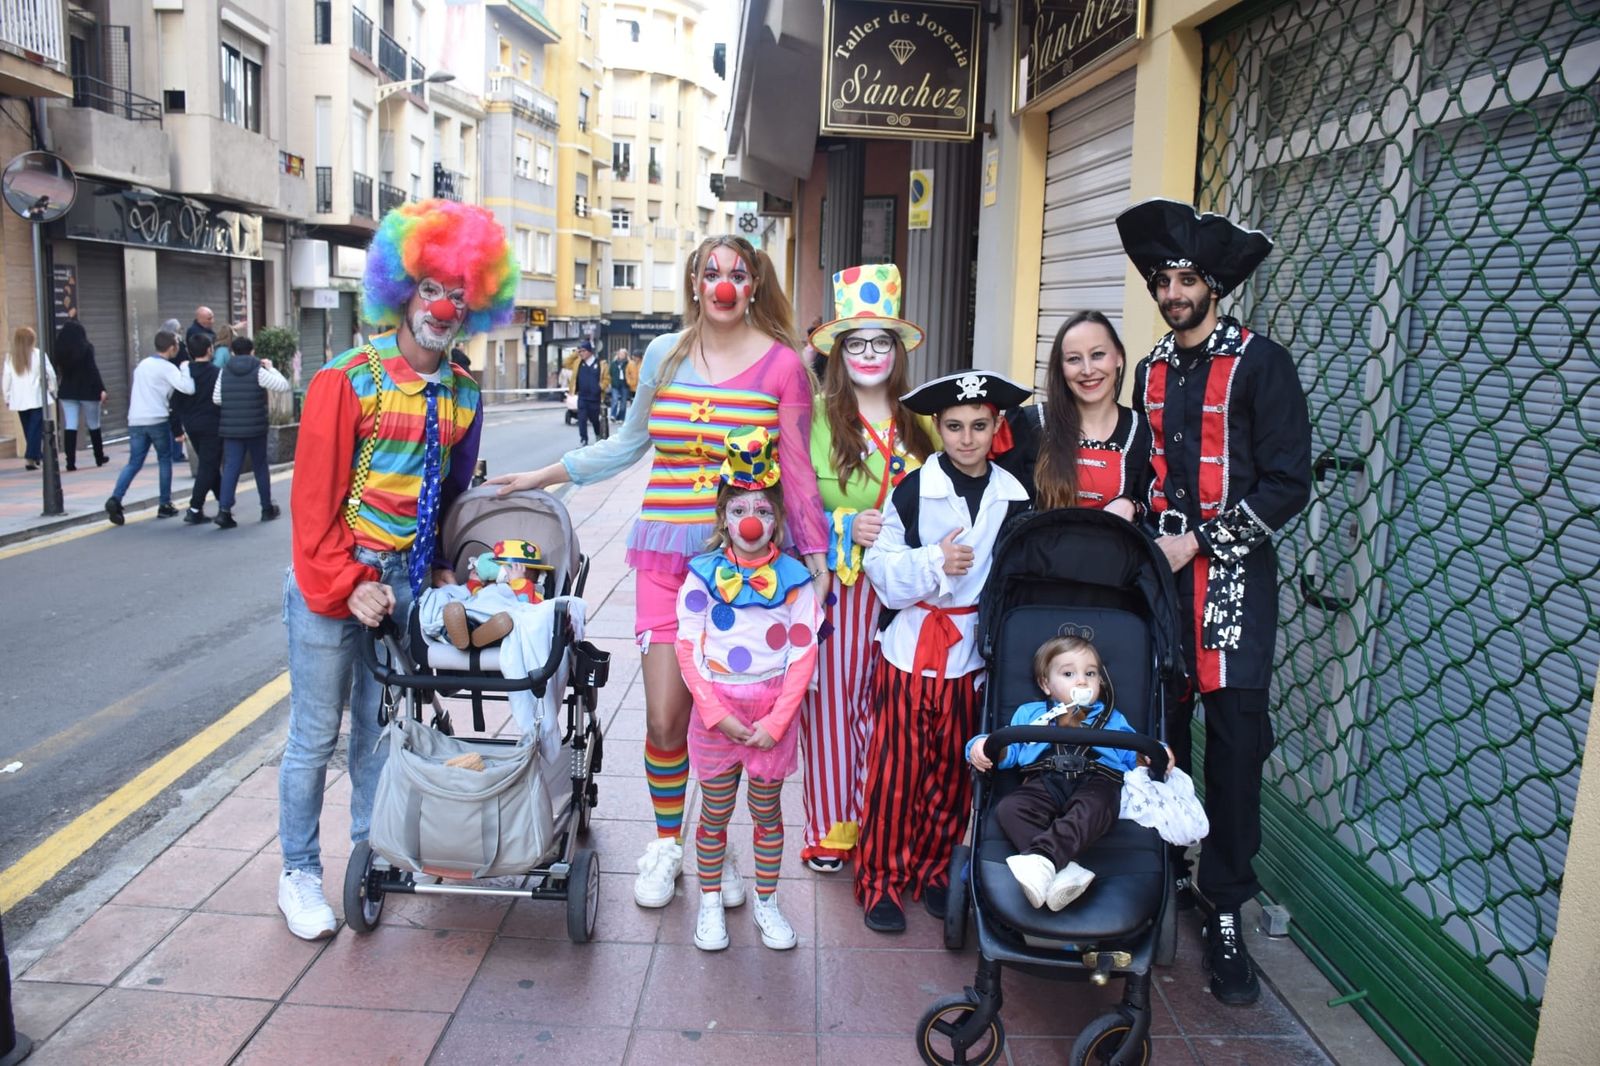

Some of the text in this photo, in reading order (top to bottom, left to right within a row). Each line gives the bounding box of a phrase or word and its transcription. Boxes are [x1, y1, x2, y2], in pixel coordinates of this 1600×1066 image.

[835, 17, 881, 59] Taller
[888, 9, 911, 24] de
[840, 63, 962, 110] Sánchez
